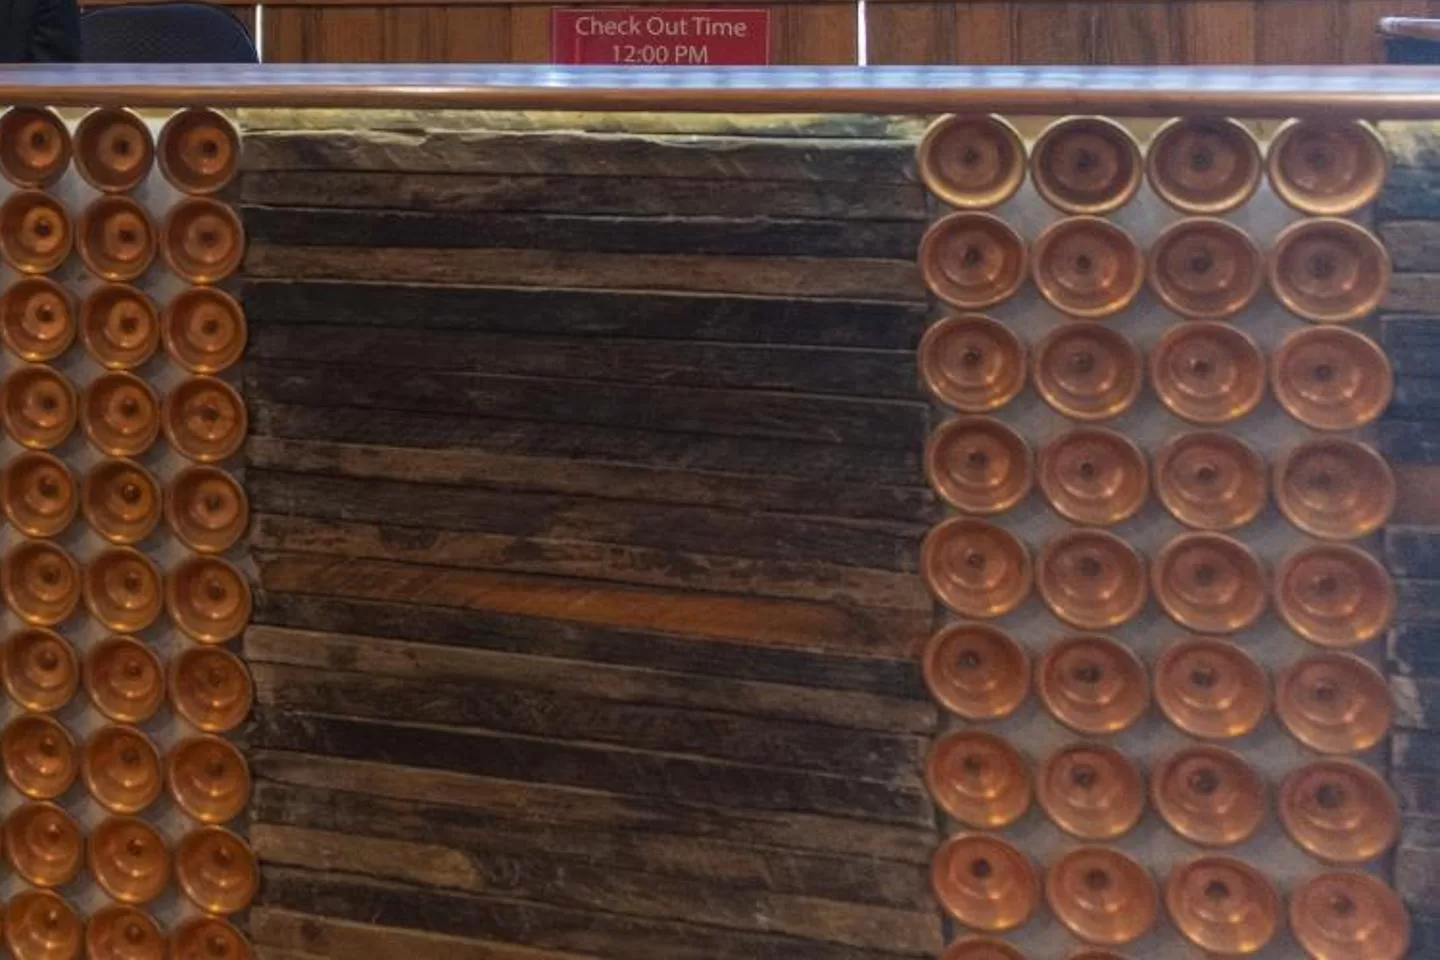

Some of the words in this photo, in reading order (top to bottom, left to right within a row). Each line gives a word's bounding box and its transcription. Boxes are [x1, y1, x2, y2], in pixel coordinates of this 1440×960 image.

[575, 16, 640, 37] Check
[646, 16, 688, 36] Out
[692, 16, 748, 37] Time
[612, 45, 669, 64] 12:00
[675, 45, 709, 64] PM
